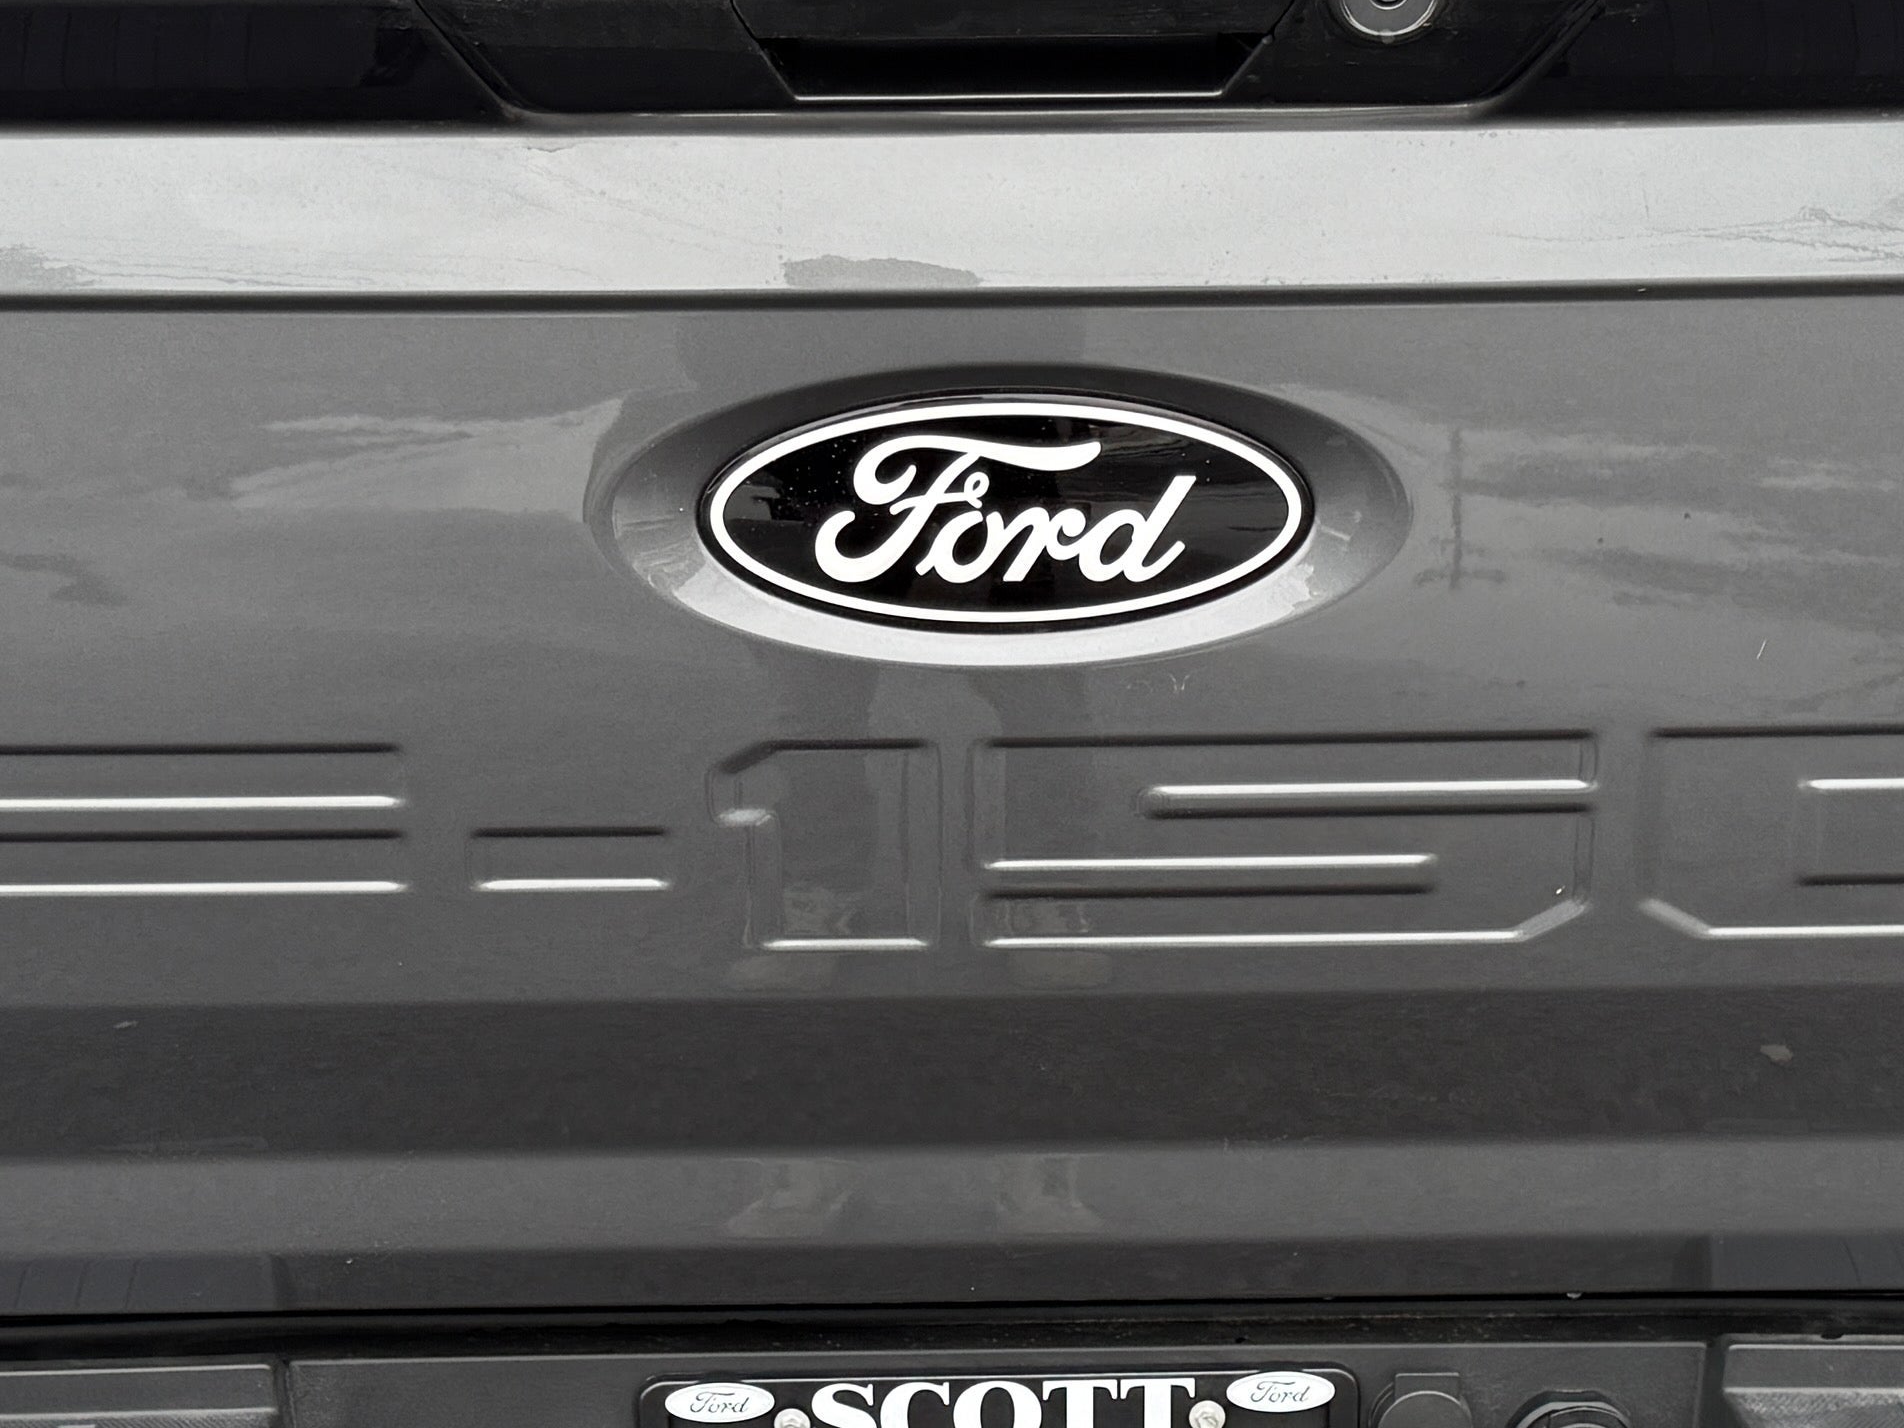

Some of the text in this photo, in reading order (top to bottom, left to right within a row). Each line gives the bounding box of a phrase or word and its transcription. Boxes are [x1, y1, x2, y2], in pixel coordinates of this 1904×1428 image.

[815, 434, 1196, 584] Ford
[690, 1391, 750, 1414] Ford
[1250, 1380, 1310, 1404] Ford
